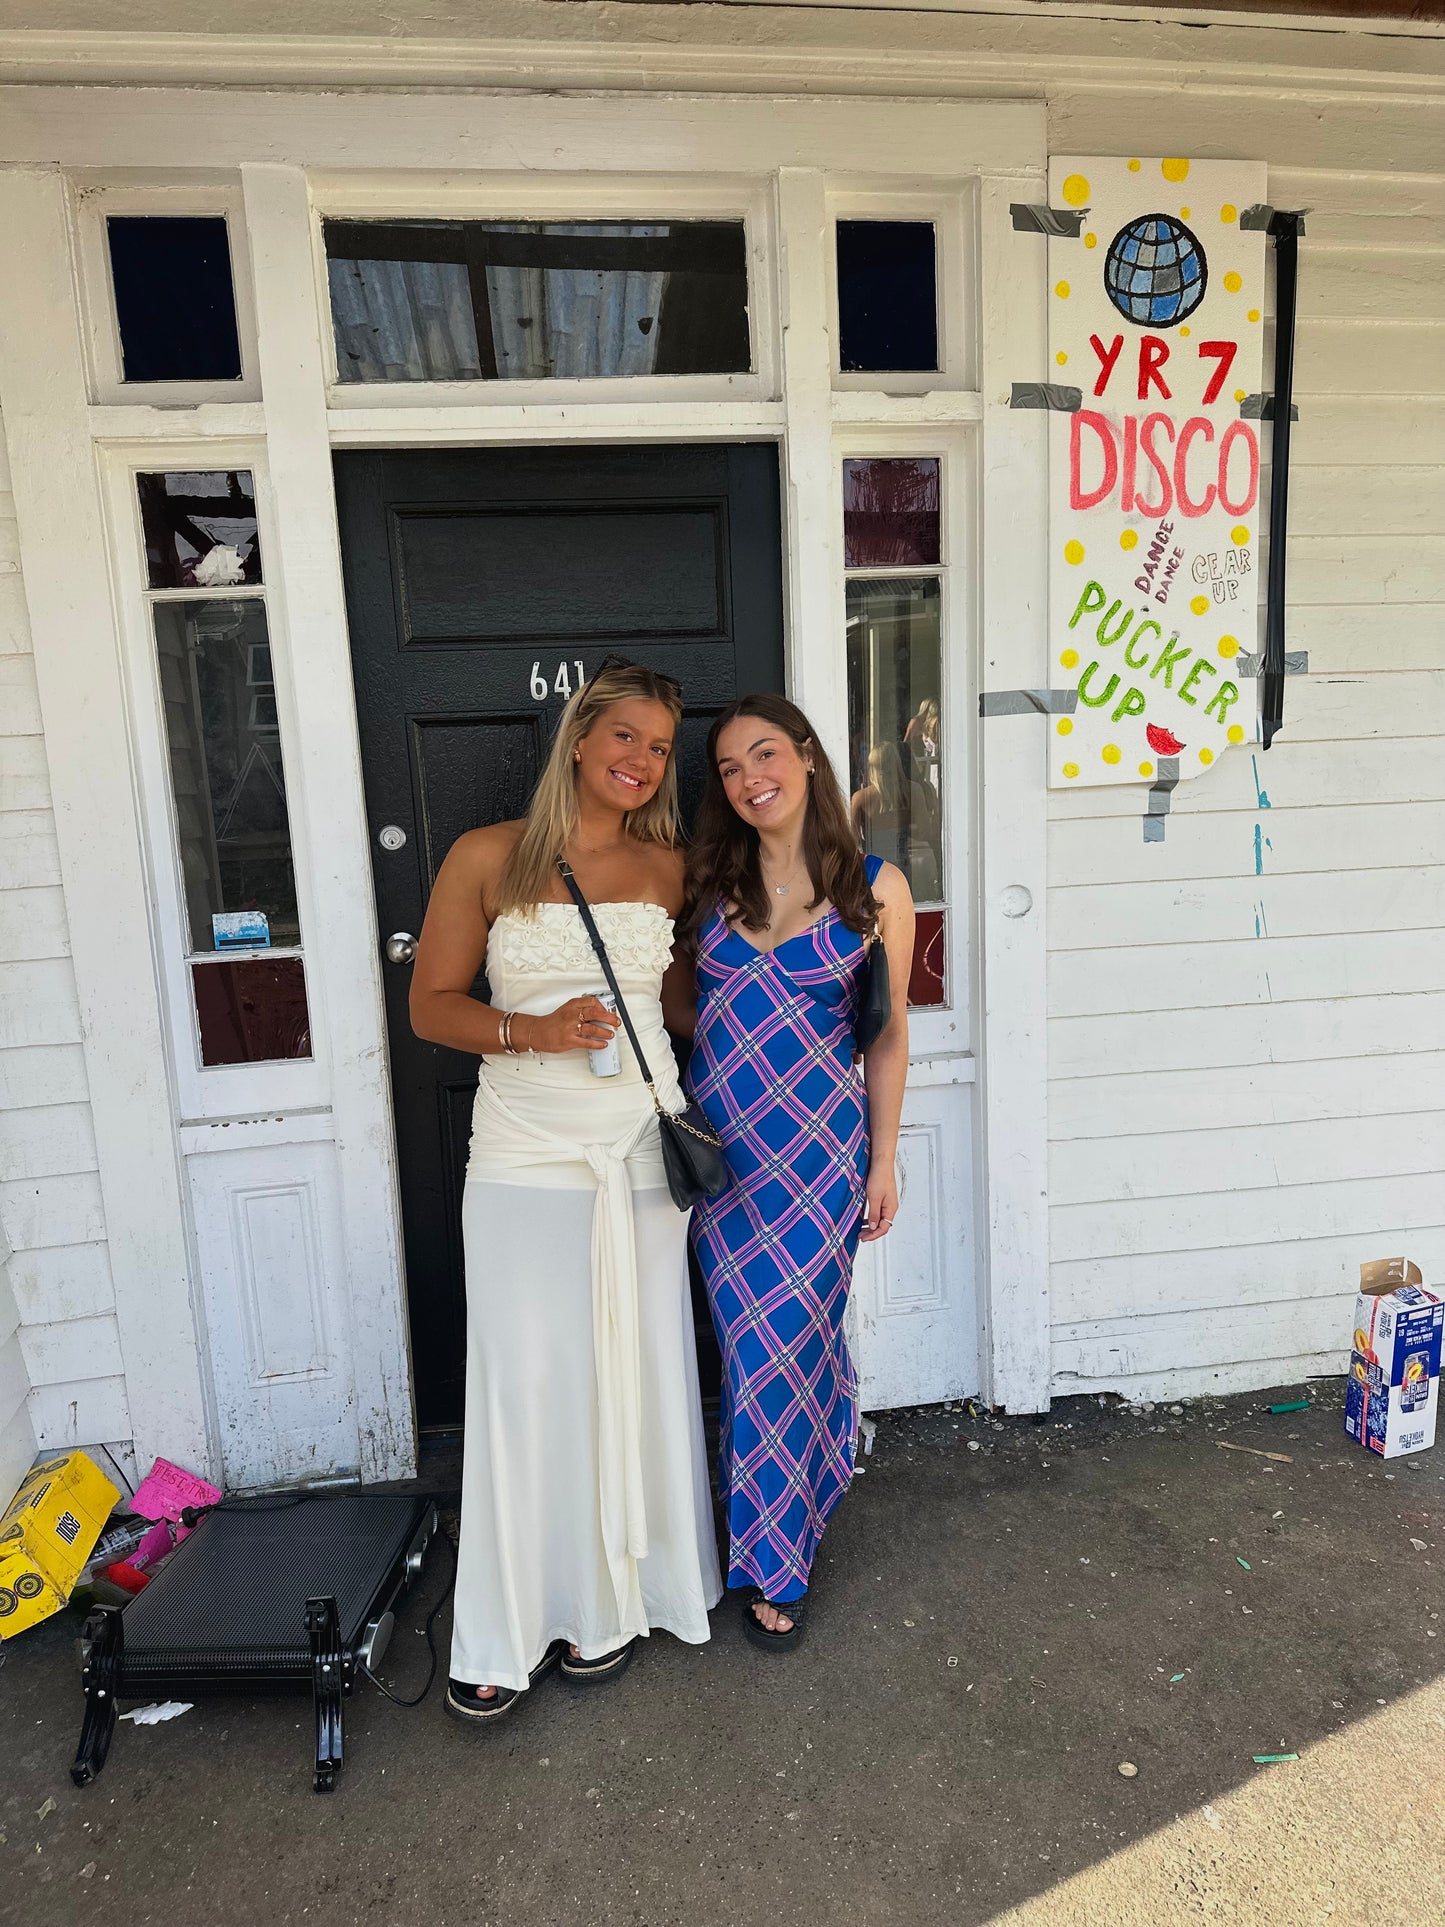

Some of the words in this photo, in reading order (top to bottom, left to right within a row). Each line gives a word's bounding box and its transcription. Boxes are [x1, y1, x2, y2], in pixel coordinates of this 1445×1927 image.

[1089, 334, 1172, 400] YR
[1198, 341, 1238, 405] 7
[1069, 408, 1260, 518] DISCO
[1134, 518, 1174, 595] DANCE
[1155, 546, 1185, 604] DANCE
[1212, 579, 1239, 605] UP
[530, 660, 585, 701] 641
[1068, 579, 1239, 725] PUCKER
[1077, 661, 1147, 723] UP
[55, 1511, 81, 1546] noise
